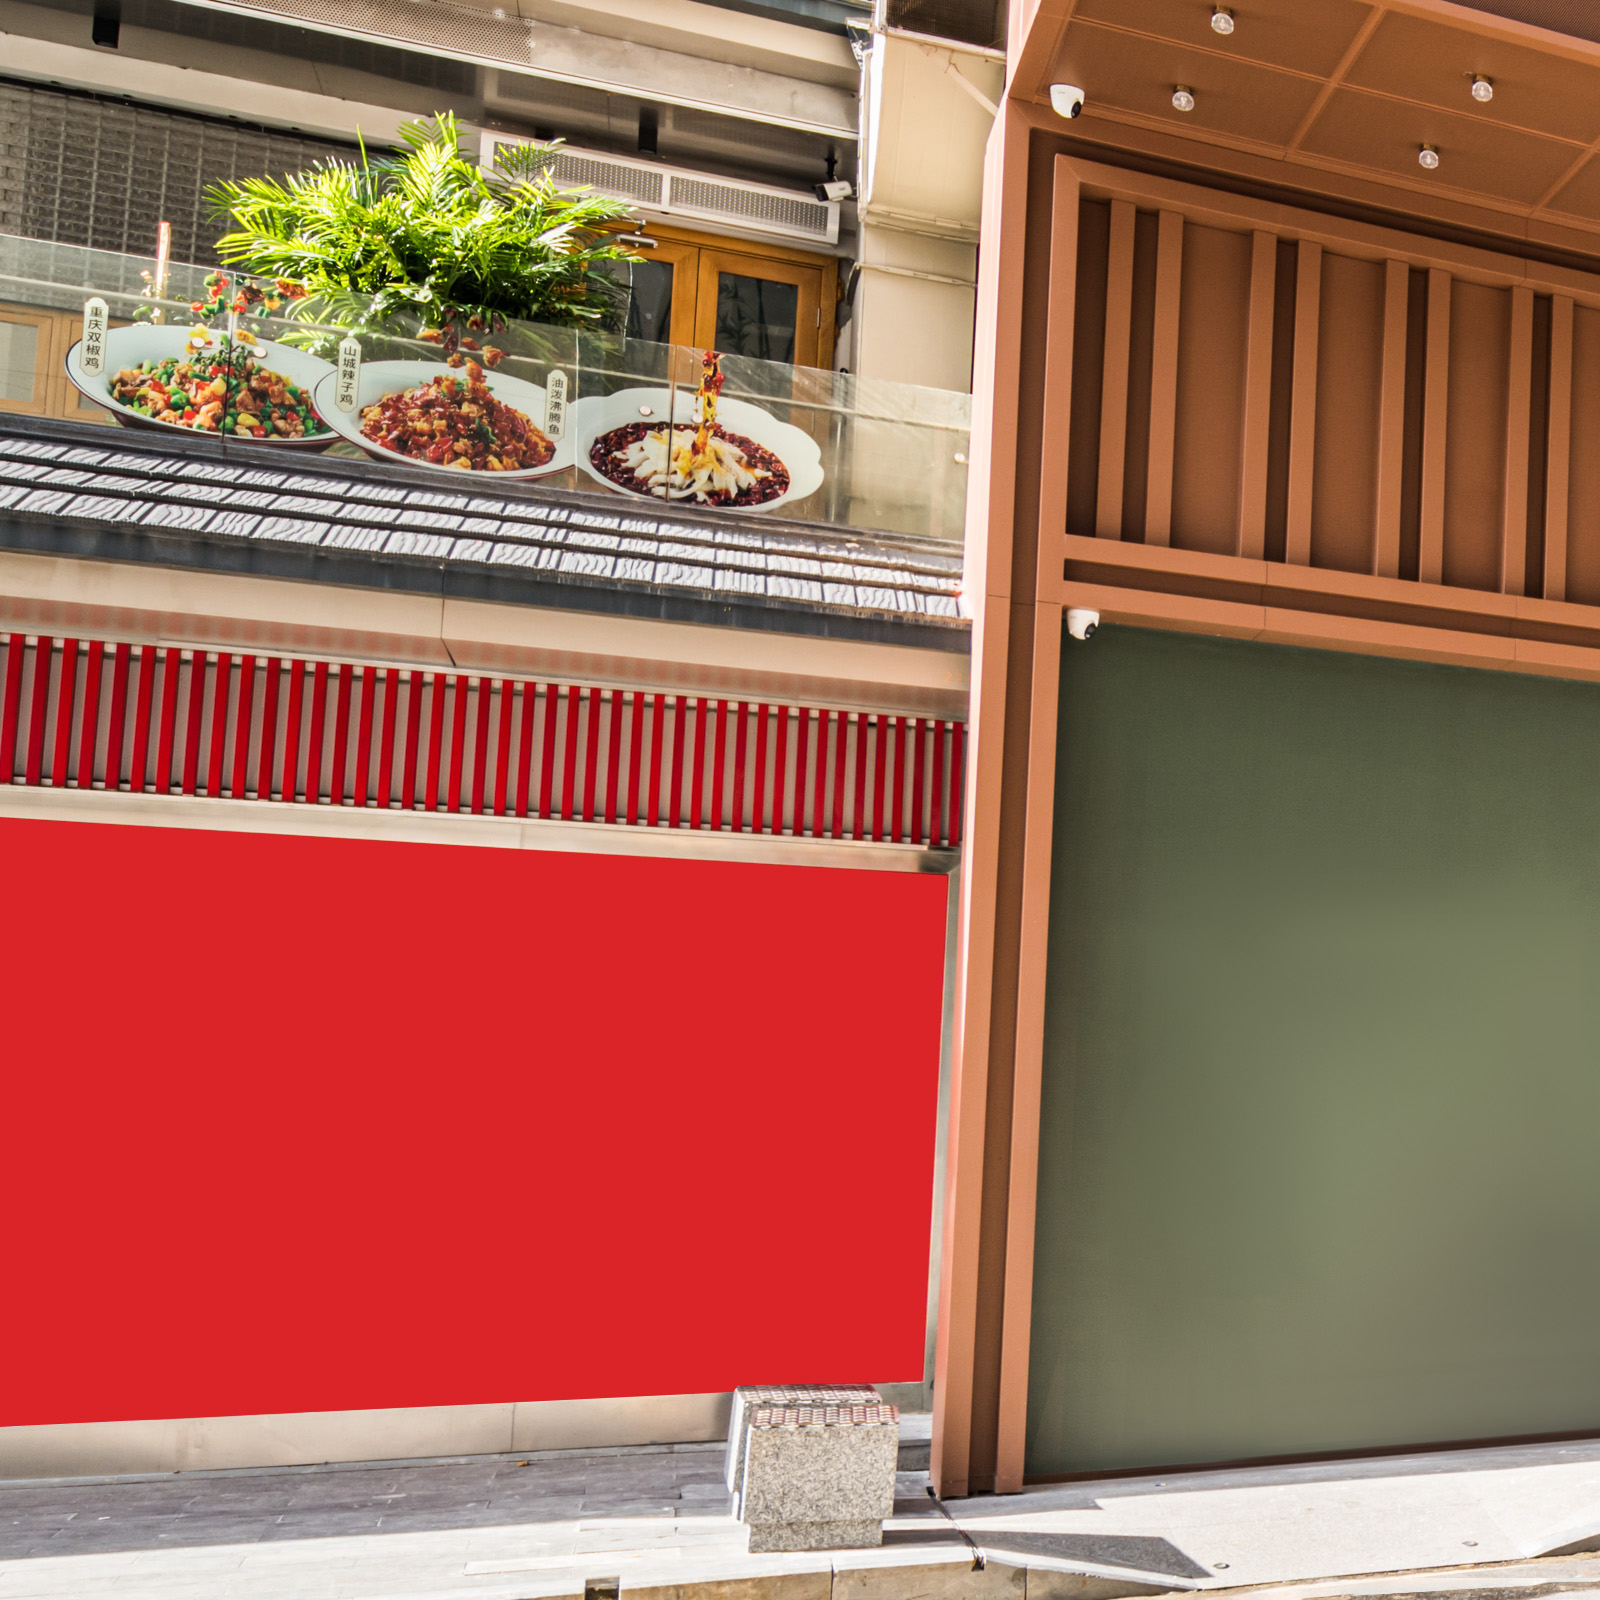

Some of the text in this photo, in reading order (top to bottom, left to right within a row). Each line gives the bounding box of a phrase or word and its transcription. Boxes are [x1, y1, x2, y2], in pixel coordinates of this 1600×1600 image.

[85, 306, 103, 369] 重庆双椒鸡
[339, 345, 357, 406] 山城辣子鸡
[548, 377, 564, 435] 油泼沸腾鱼
